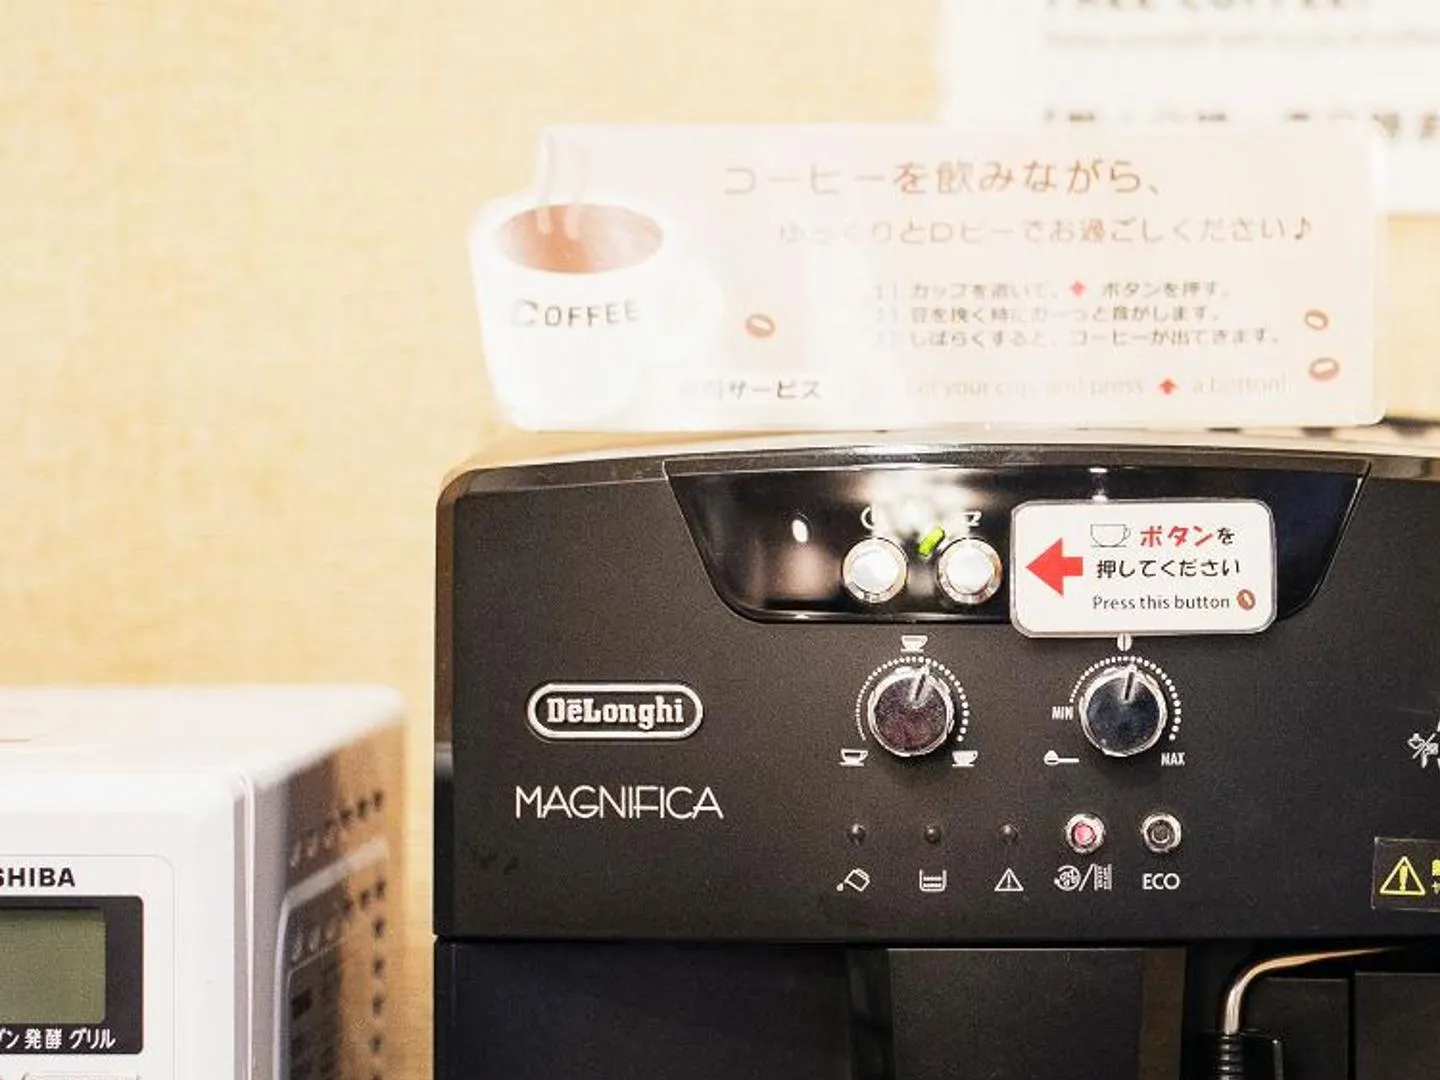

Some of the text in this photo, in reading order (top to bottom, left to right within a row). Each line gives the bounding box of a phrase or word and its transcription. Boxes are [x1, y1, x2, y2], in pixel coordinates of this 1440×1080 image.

[725, 158, 1161, 196] コーヒーを飲みながら、
[511, 298, 641, 329] COFFEE
[1140, 525, 1236, 547] ボタンを
[1096, 558, 1240, 579] 押してください
[1093, 594, 1231, 610] Press this button
[1051, 706, 1074, 721] MIN
[1161, 752, 1186, 766] MAX
[515, 785, 725, 820] MAGNIFICA
[1142, 873, 1181, 890] ECO
[24, 1028, 62, 1049] 発酵
[69, 1027, 117, 1049] グリル
